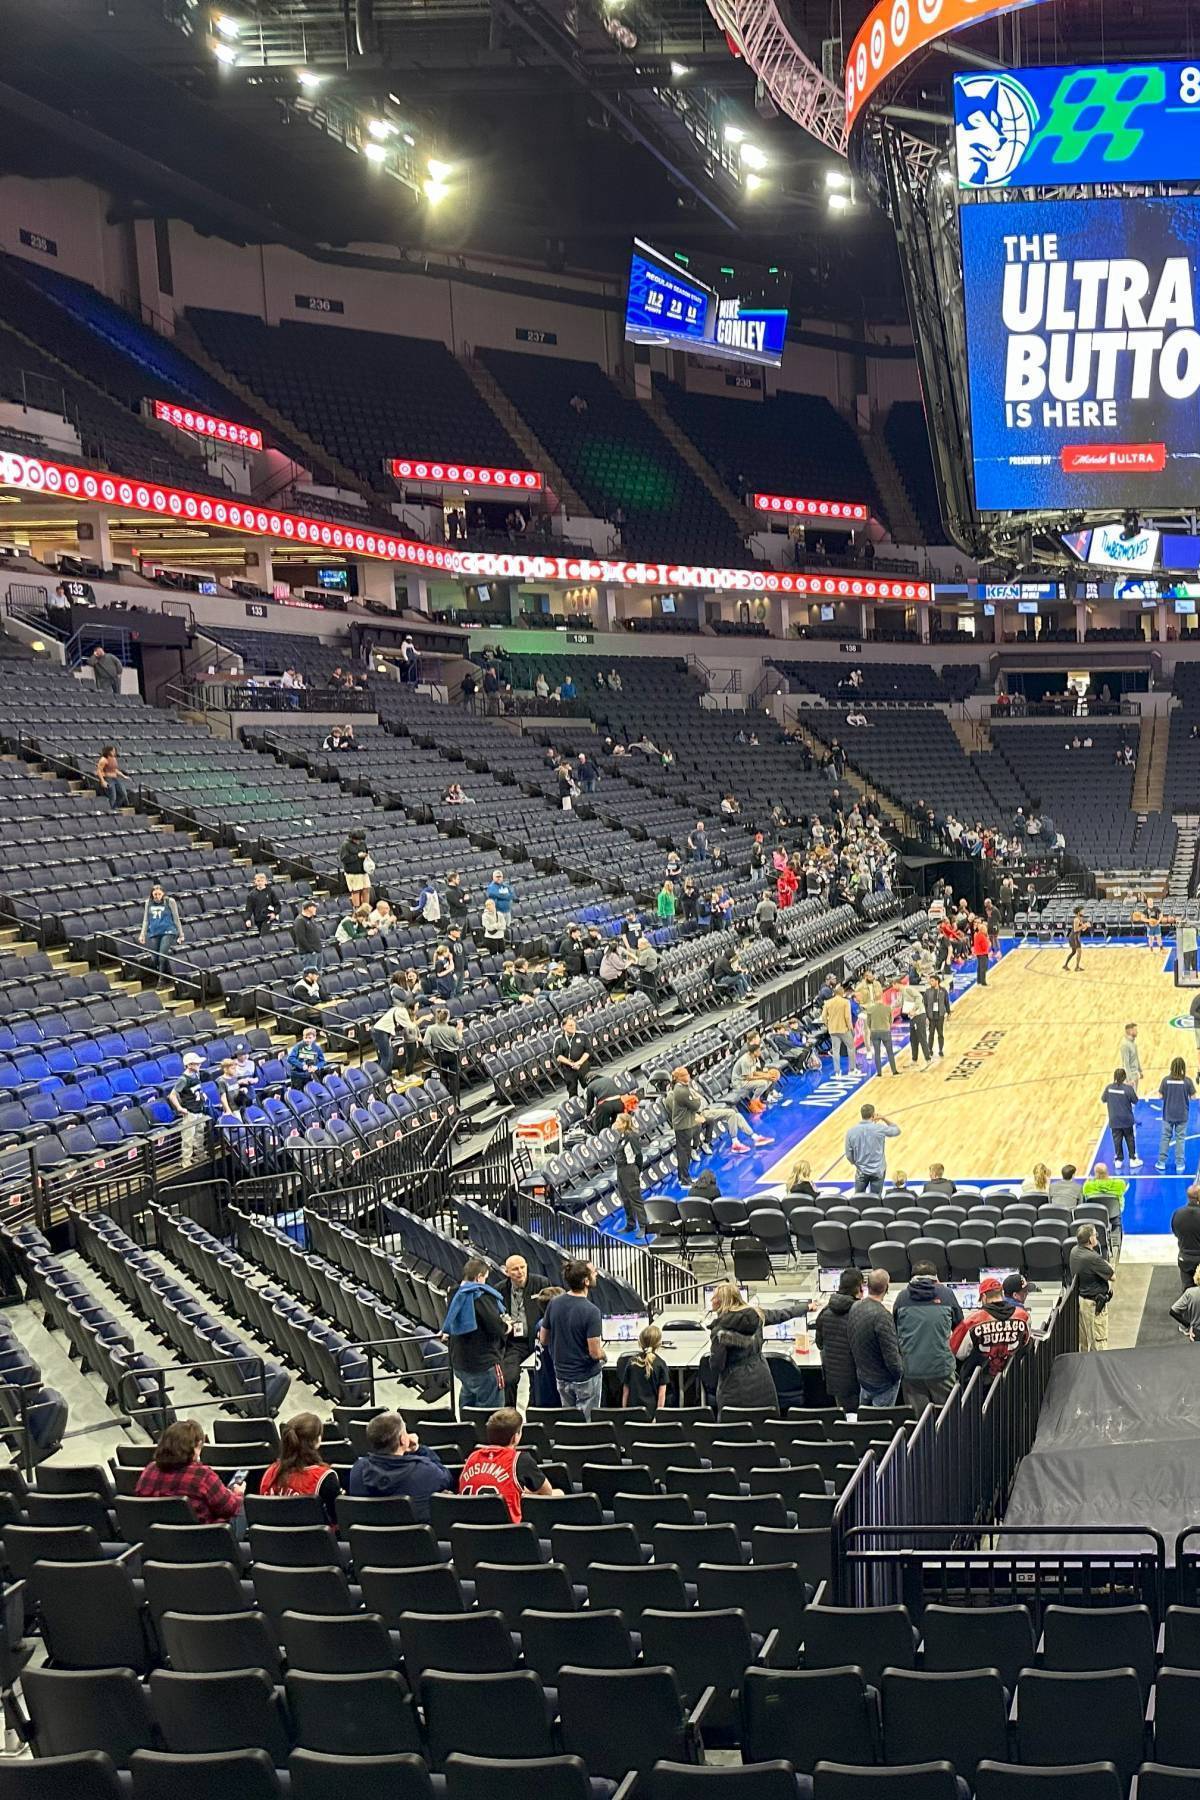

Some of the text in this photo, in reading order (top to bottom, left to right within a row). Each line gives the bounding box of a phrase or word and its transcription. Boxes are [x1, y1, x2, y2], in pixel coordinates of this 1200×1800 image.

[1003, 235, 1058, 260] THE
[1001, 257, 1195, 332] ULTRA
[719, 300, 741, 320] MIKE
[717, 320, 766, 352] CONLEY
[1005, 400, 1118, 428] IS HERE
[1117, 453, 1154, 464] ULTRA
[68, 583, 84, 597] 132
[986, 585, 1019, 599] KFAN
[251, 606, 263, 616] 133
[974, 1320, 1025, 1337] CHICAGO
[983, 1331, 1018, 1344] BULLS
